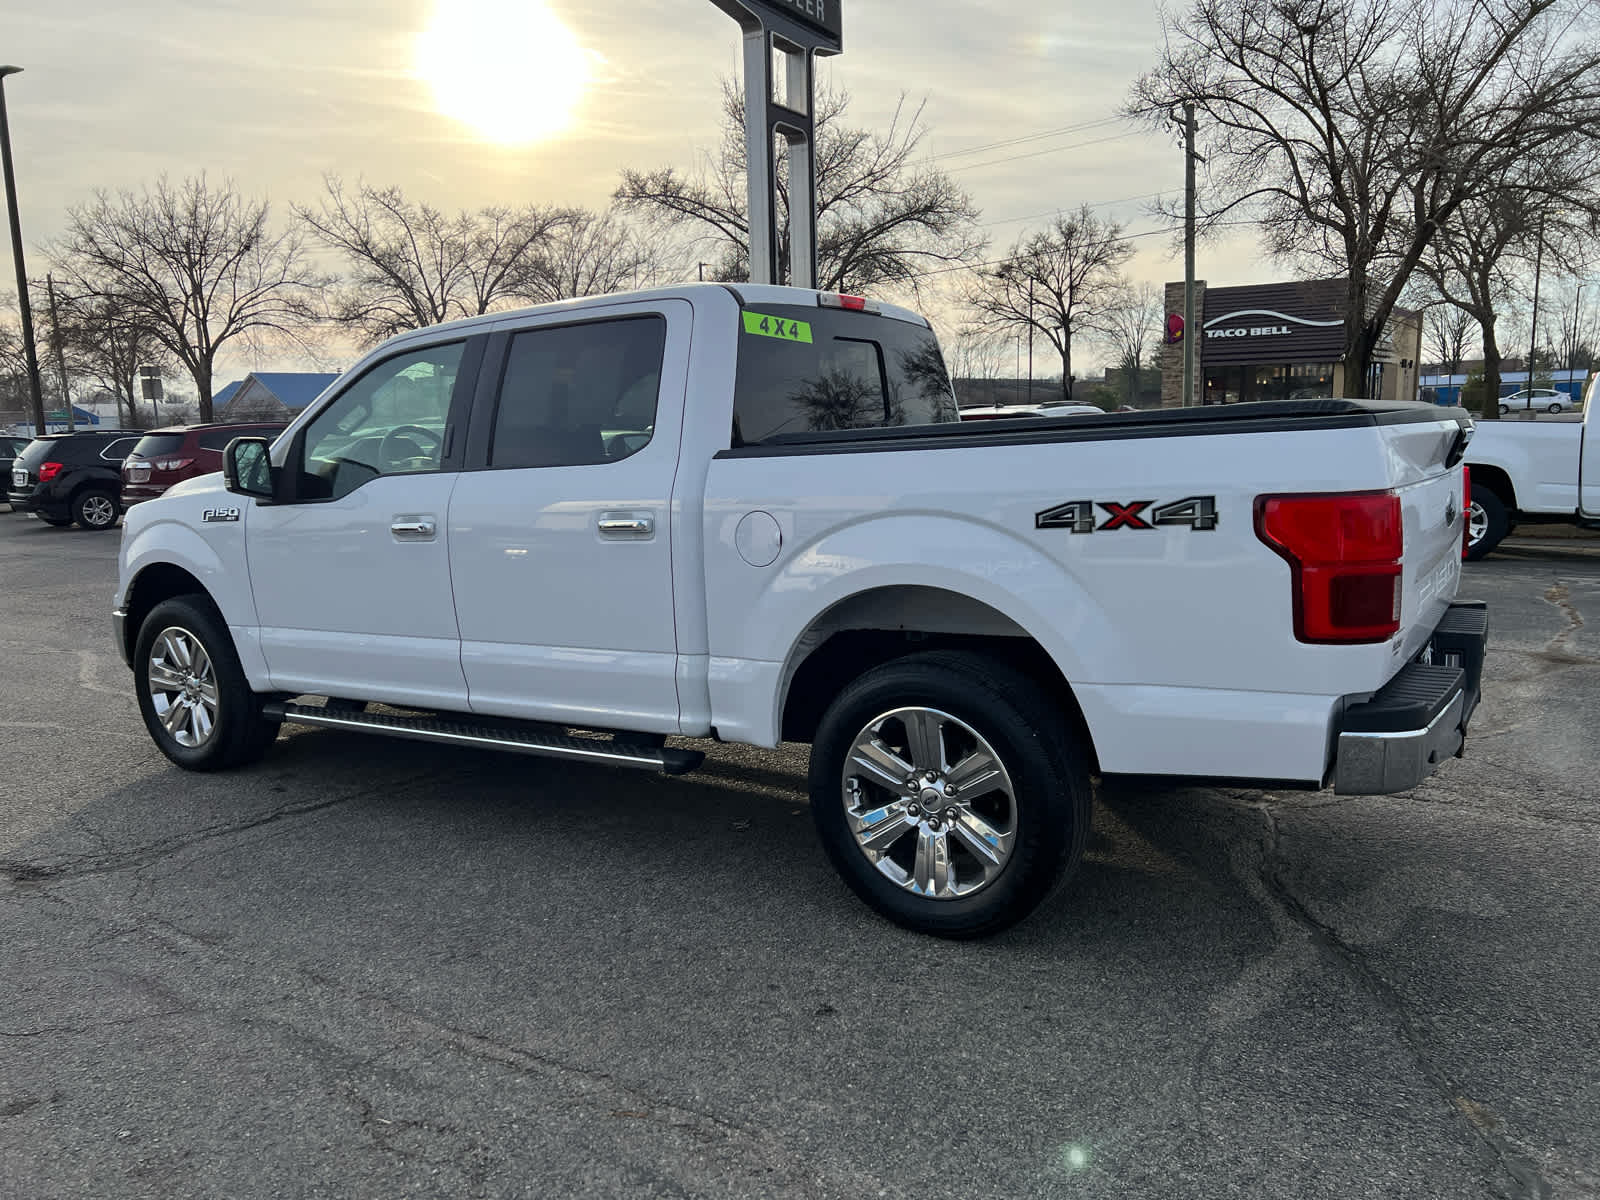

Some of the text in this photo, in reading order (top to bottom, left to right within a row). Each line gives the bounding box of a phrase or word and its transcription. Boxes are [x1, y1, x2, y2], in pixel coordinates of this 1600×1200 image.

[759, 316, 799, 339] 4X4
[1205, 326, 1292, 338] TACO BELL
